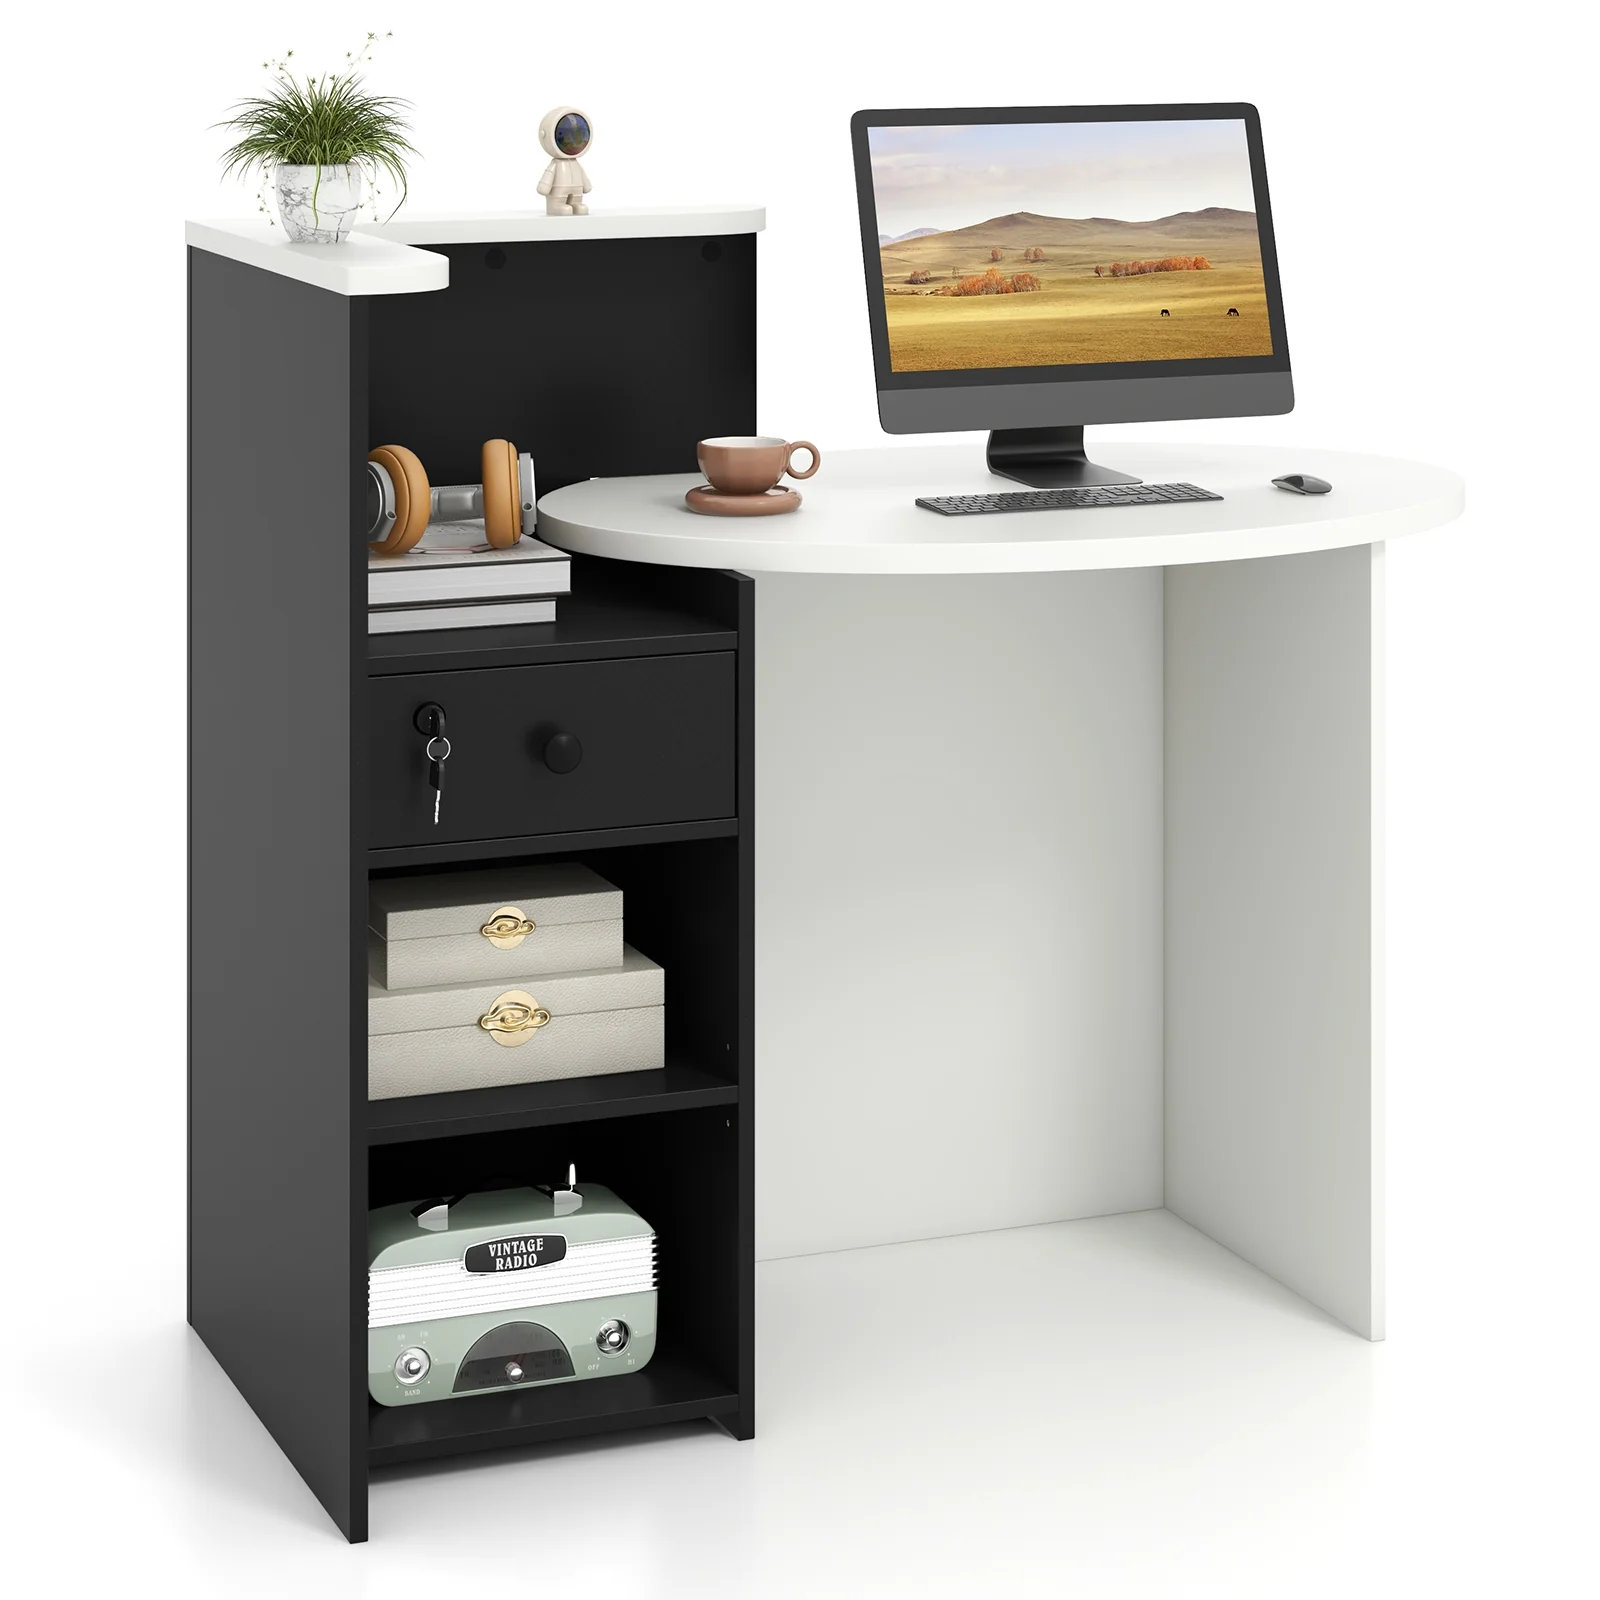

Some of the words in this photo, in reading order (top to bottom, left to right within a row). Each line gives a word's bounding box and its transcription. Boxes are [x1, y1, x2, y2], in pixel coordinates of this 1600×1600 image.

[488, 1238, 544, 1257] VINTAGE
[495, 1253, 538, 1271] RADIO
[587, 1363, 600, 1371] OFF
[404, 1389, 421, 1397] BAND
